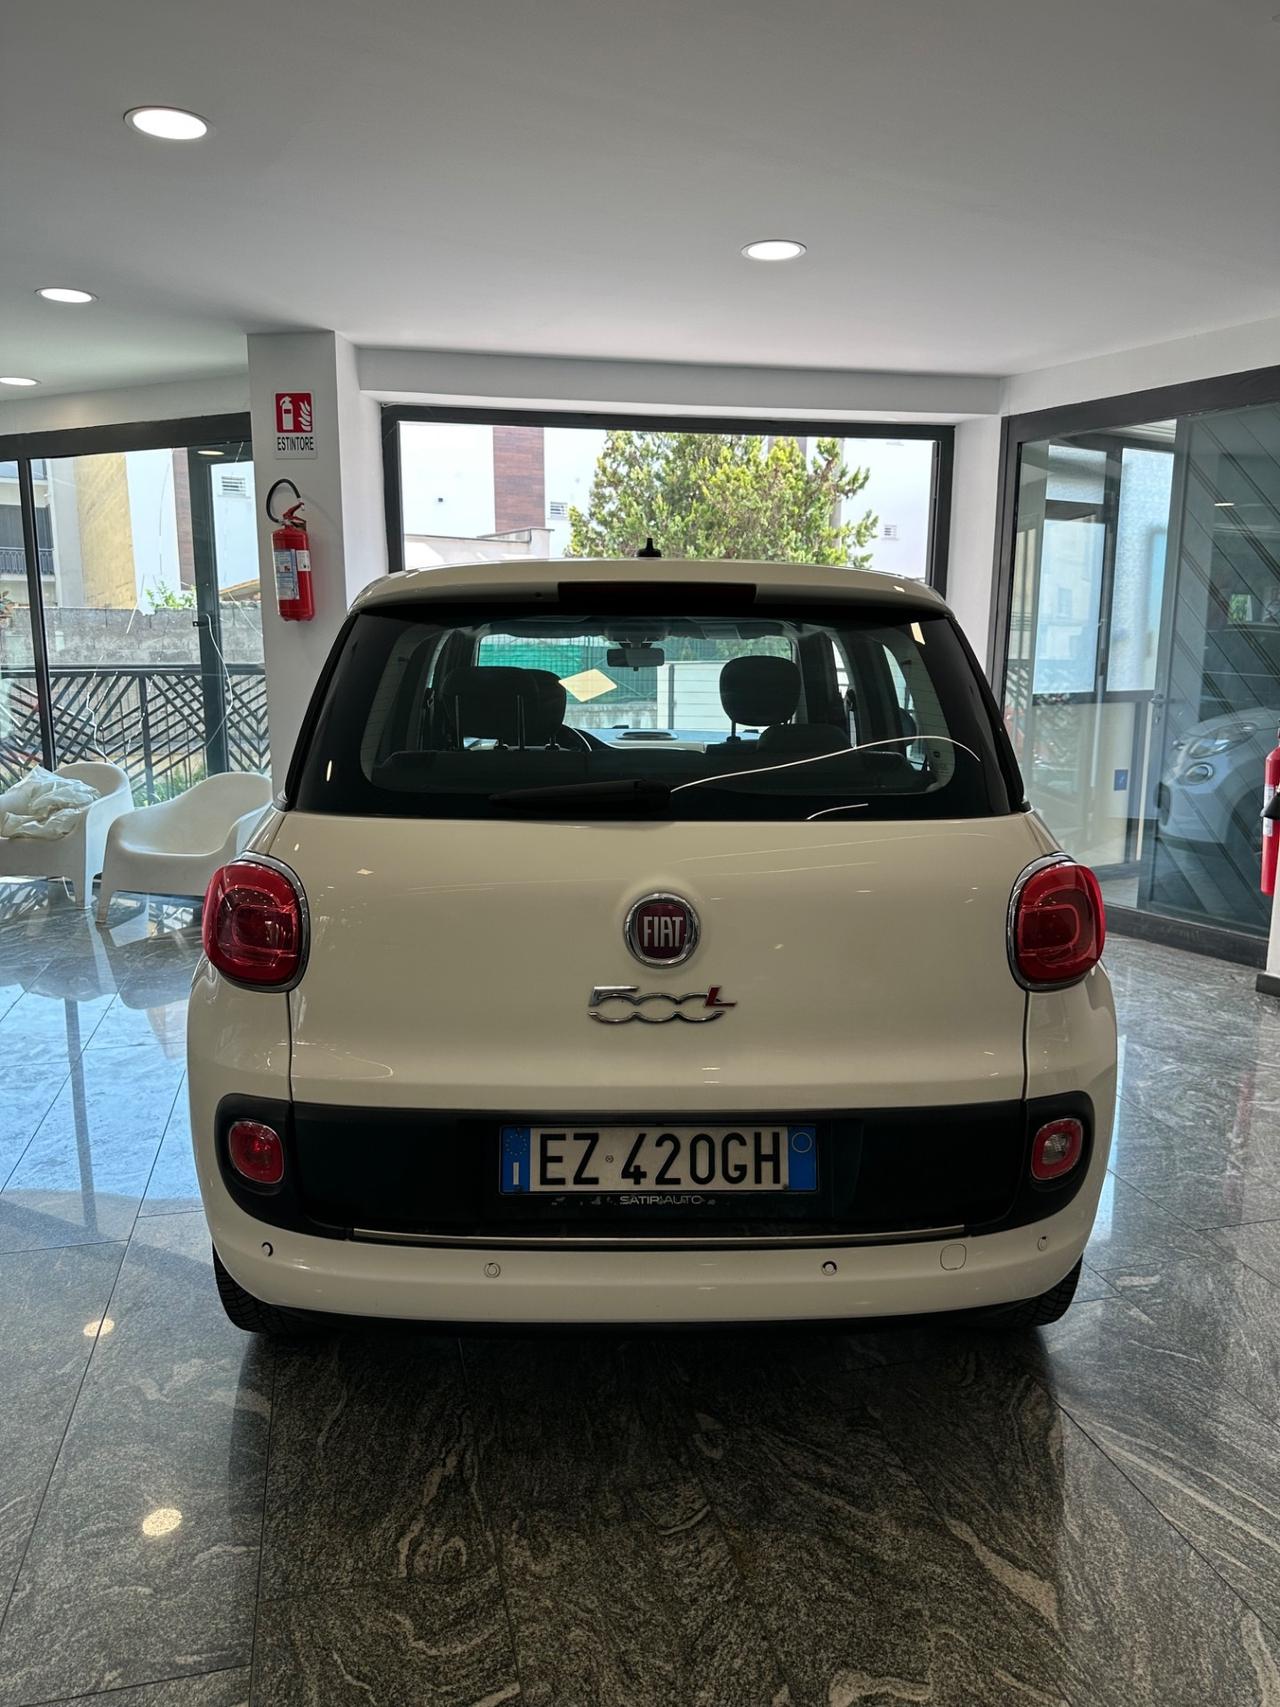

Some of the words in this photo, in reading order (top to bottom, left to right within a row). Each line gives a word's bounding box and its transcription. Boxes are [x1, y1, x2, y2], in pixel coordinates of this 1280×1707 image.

[277, 436, 314, 451] ESTINTORE
[643, 916, 683, 947] FIAT
[588, 985, 737, 1024] 500L
[539, 1132, 599, 1185] EZ
[621, 1132, 781, 1185] 420GH
